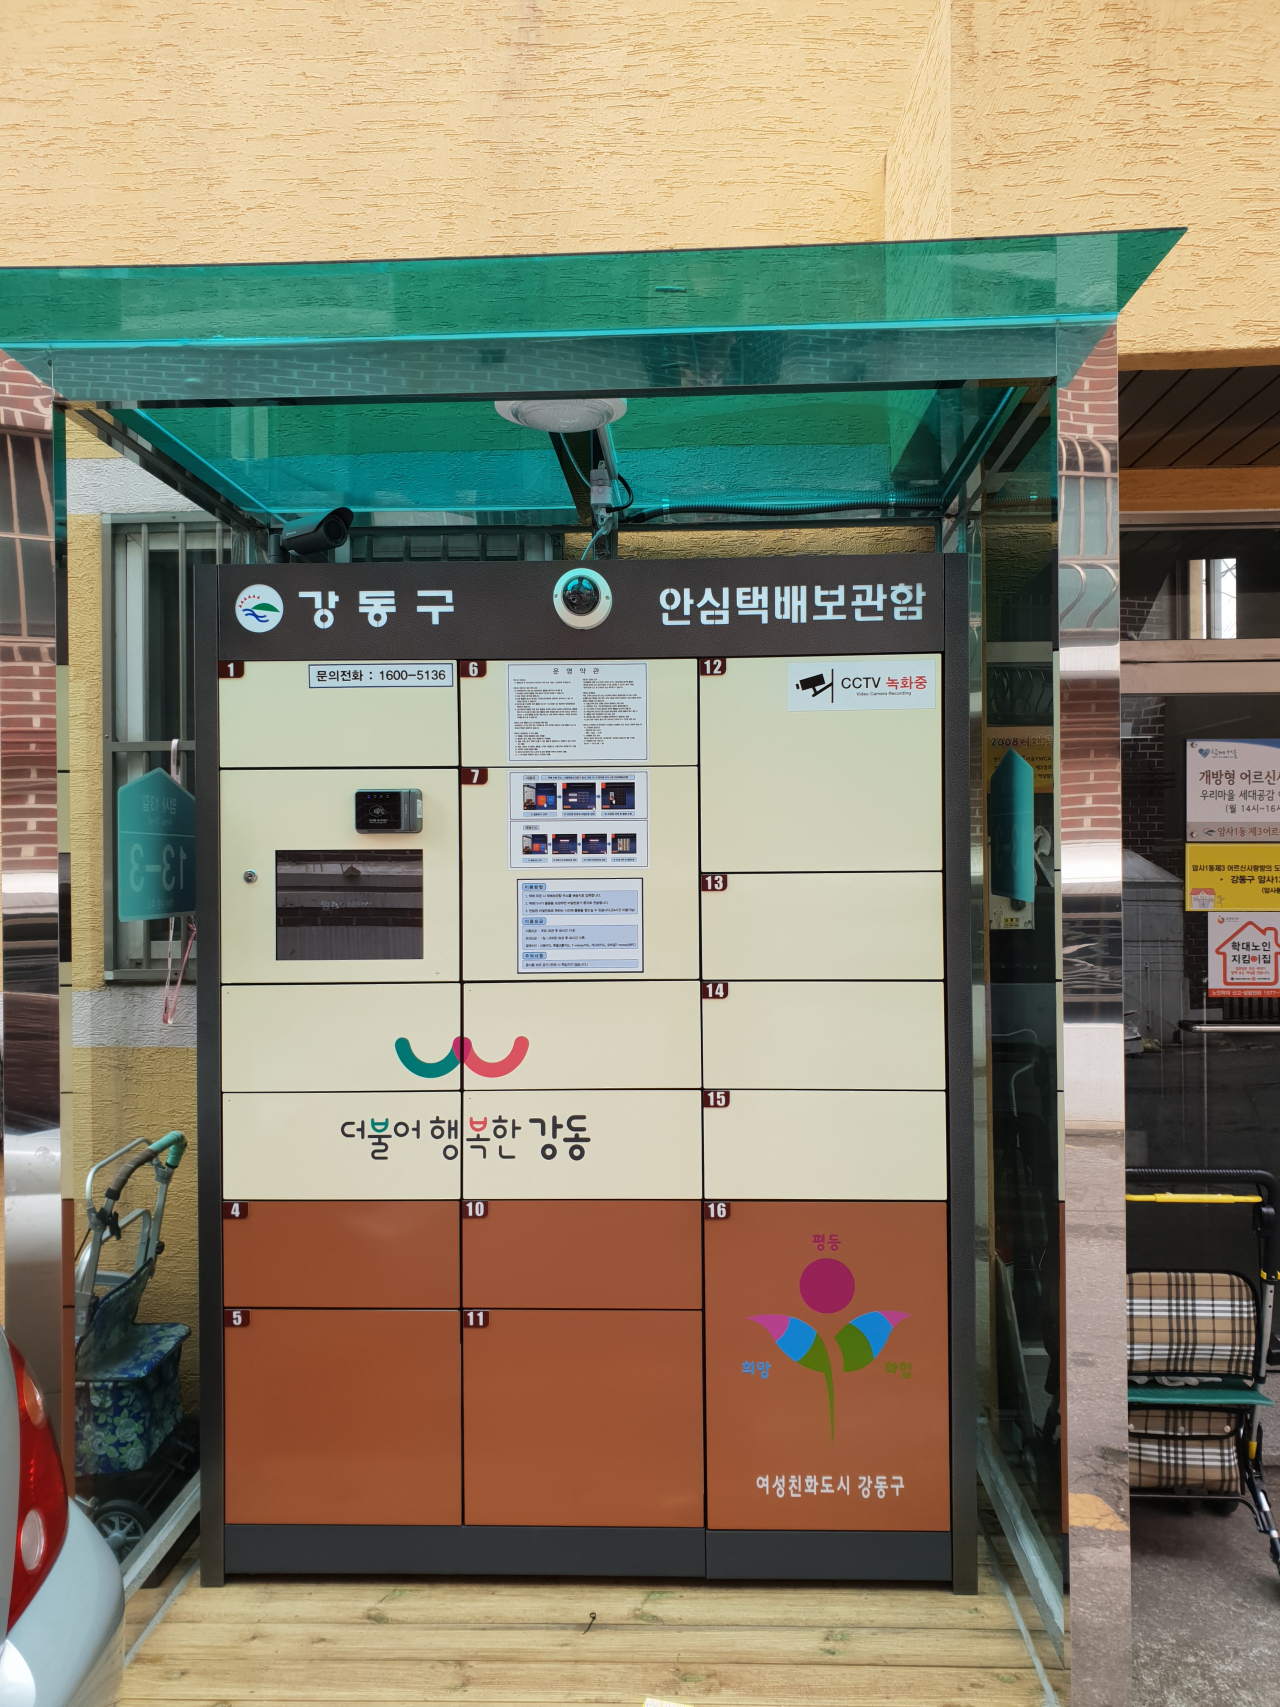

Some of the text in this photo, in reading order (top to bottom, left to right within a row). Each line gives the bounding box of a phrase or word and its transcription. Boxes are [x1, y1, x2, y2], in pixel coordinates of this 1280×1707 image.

[298, 589, 455, 630] 강동구
[659, 582, 927, 627] 안심택배보관함
[227, 662, 235, 677] 1
[468, 661, 479, 677] 6
[703, 659, 722, 675] 12
[315, 668, 364, 683] 문의전화
[378, 668, 447, 682] 1600-5136
[841, 675, 928, 691] CCTV 녹화중
[470, 769, 480, 784] 7
[1199, 769, 1235, 786] 개방형
[1200, 789, 1236, 802] 우리마을
[1239, 789, 1275, 802] 세대공감
[1225, 804, 1237, 814] (월
[1217, 826, 1280, 837] 암사1동 제3어르
[705, 875, 724, 890] 13
[1230, 875, 1256, 884] 강동구
[1231, 941, 1271, 952] 학대노인
[1231, 954, 1271, 964] 지킴이집
[706, 983, 724, 998] 14
[707, 1091, 726, 1106] 15
[340, 1114, 591, 1161] 더불어 행복한 강동
[230, 1202, 241, 1218] 4
[466, 1201, 484, 1217] 10
[707, 1202, 727, 1218] 16
[811, 1233, 841, 1252] 평등
[232, 1310, 242, 1326] 5
[467, 1311, 484, 1326] 11
[741, 1361, 771, 1379] 희망
[755, 1474, 905, 1499] 여성친화도시 강동구
